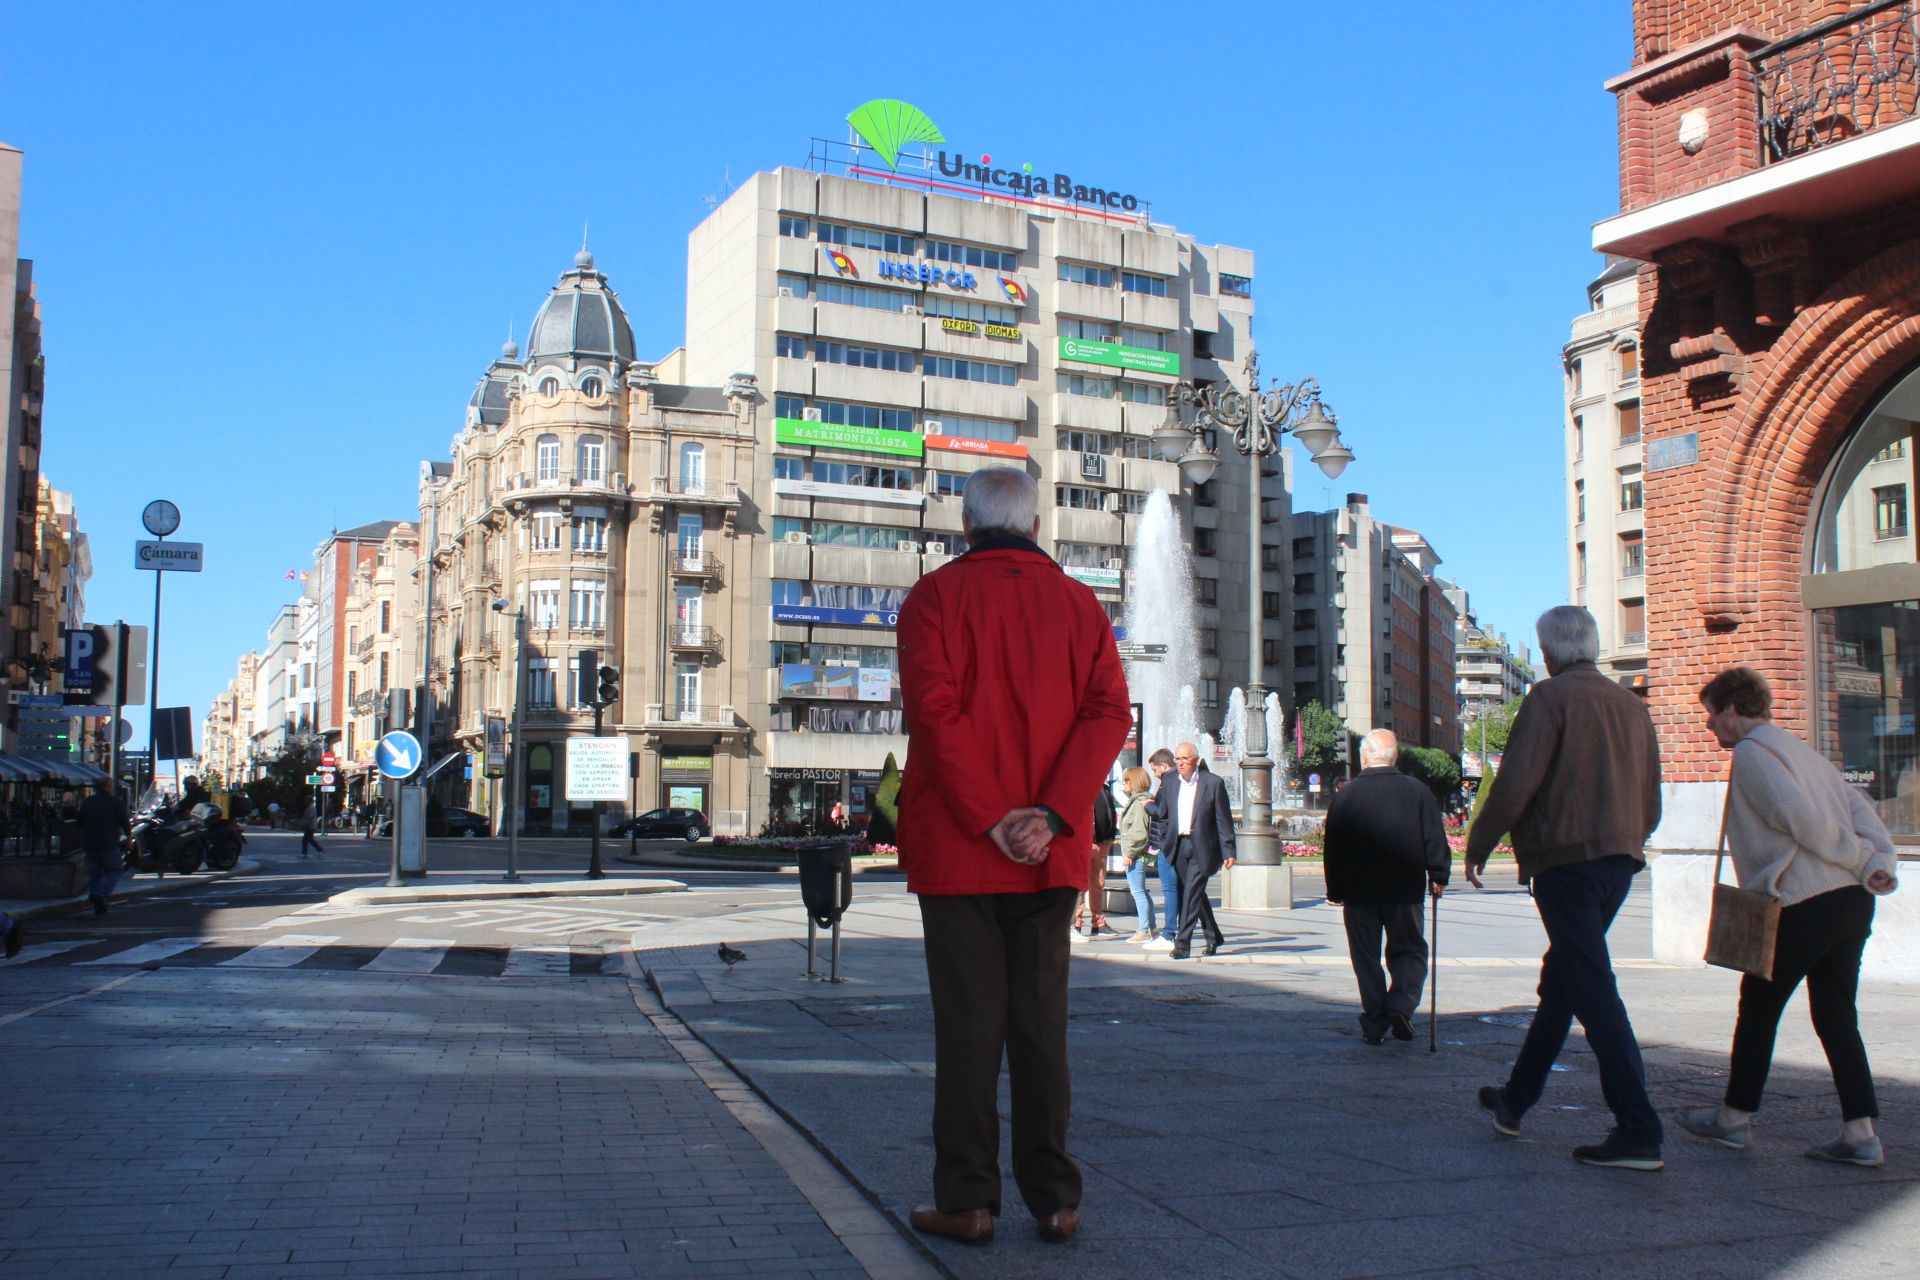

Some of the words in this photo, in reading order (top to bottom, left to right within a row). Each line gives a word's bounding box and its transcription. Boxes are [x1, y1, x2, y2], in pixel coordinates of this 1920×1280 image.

[938, 151, 1049, 197] Unicaja
[1054, 173, 1137, 211] Banco
[879, 258, 977, 289] INSEFOR
[942, 319, 977, 332] OXFORD
[985, 324, 1019, 338] IDIOMAS
[794, 427, 909, 448] MATRIMONIALISTA
[961, 441, 989, 450] ARRIAGA
[140, 545, 198, 561] Cámara
[777, 612, 820, 621] www.ocaso.es
[70, 632, 93, 670] P
[802, 768, 841, 780] PASTOR
[857, 770, 880, 778] Phone
